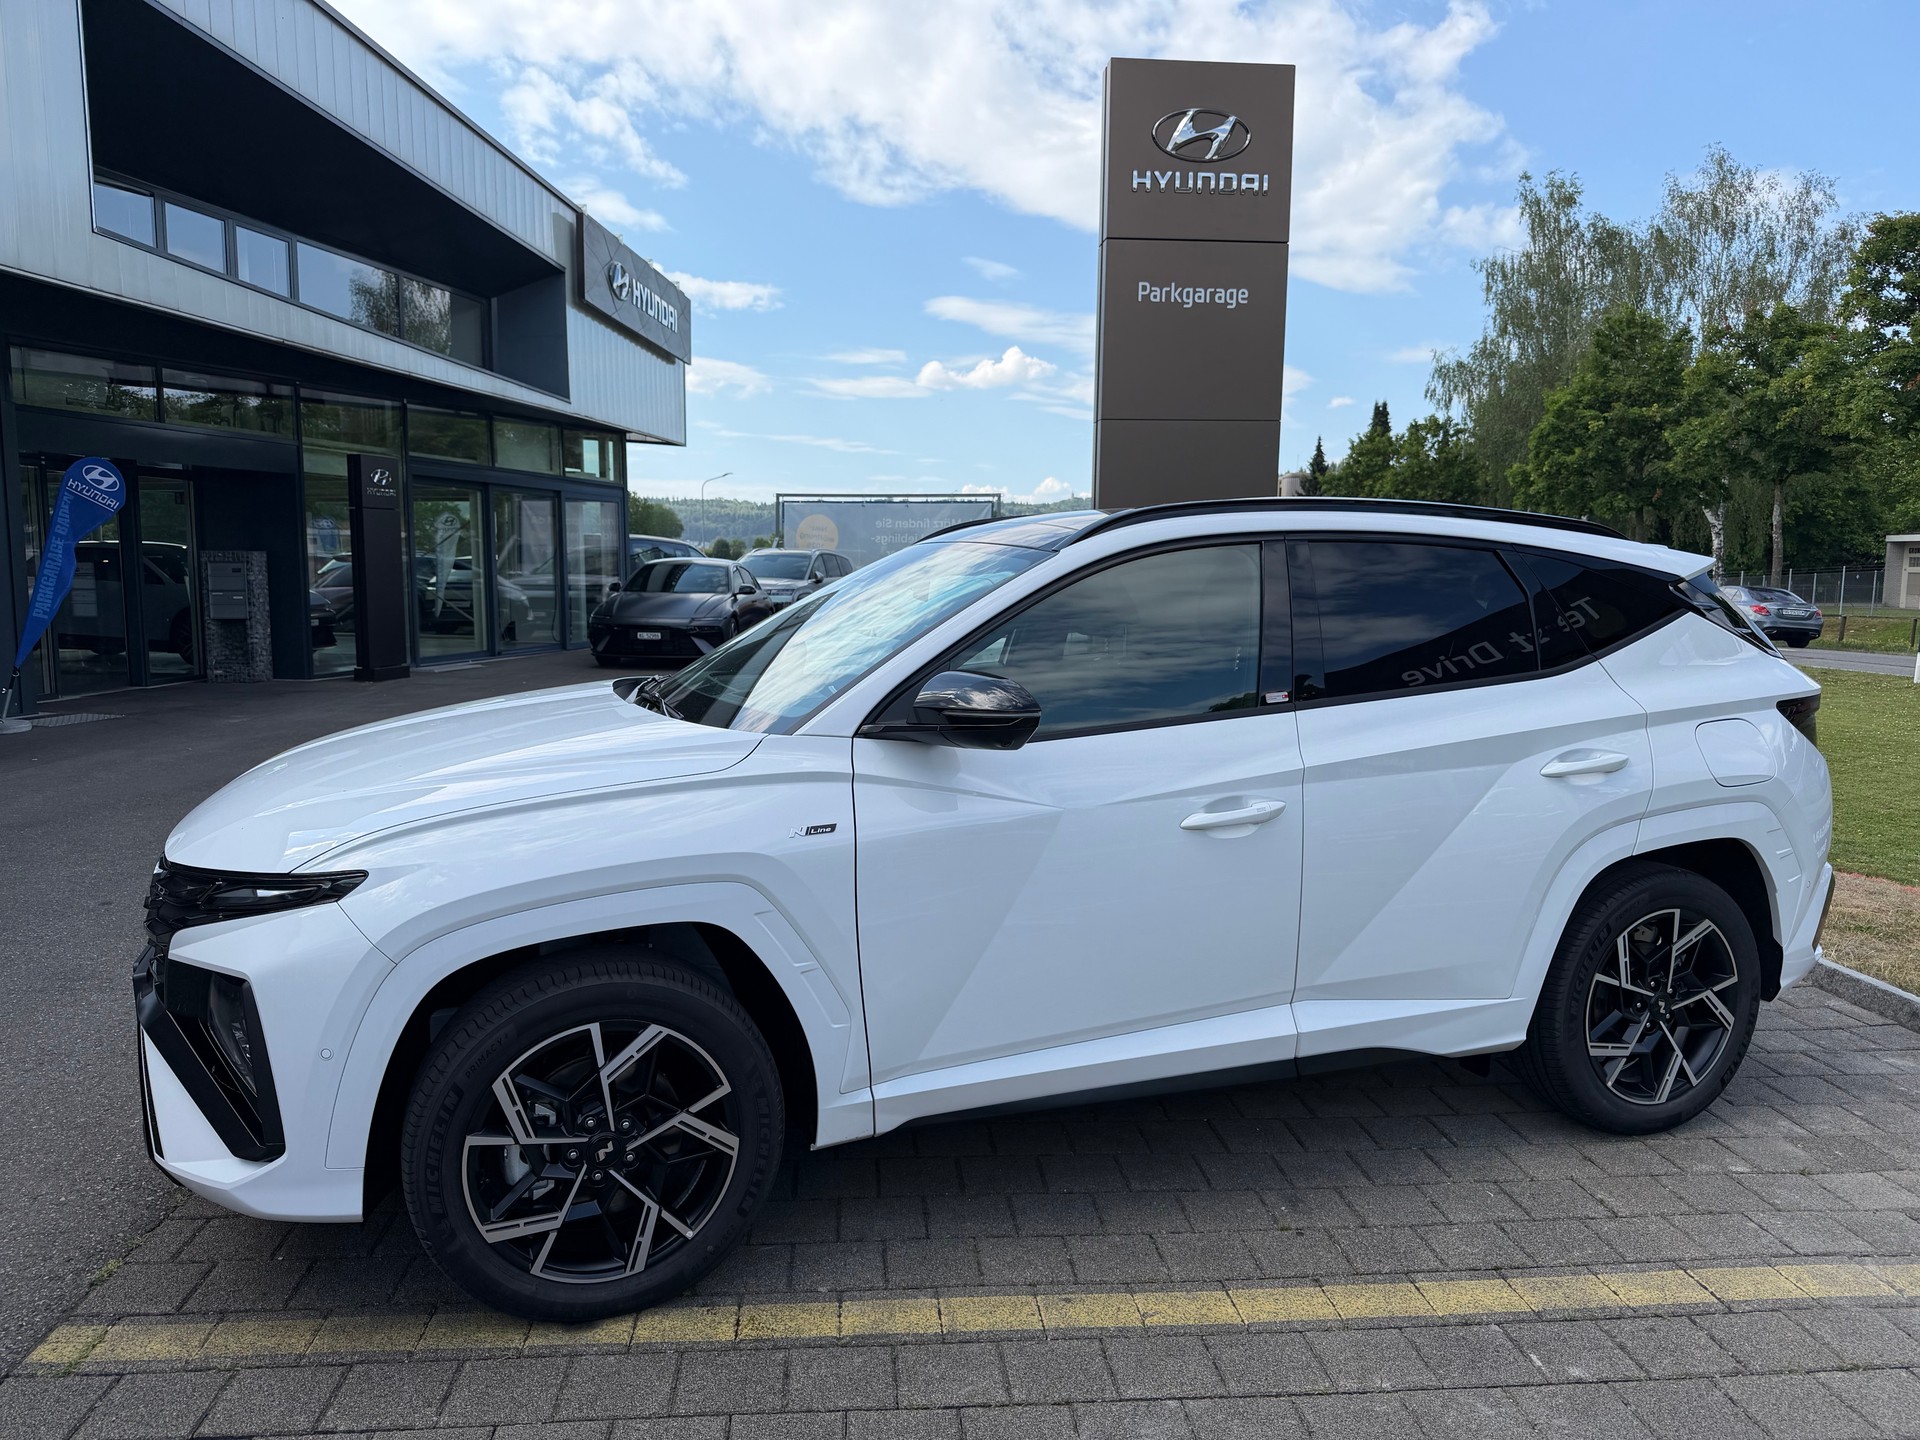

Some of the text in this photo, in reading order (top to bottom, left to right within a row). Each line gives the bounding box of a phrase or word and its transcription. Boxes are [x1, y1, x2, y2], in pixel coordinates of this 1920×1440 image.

[1131, 169, 1269, 196] HYUNDAI
[632, 278, 678, 333] HYUNDAI
[1137, 281, 1249, 308] Parkgarage
[67, 478, 120, 511] HYUNDAI
[33, 491, 75, 620] PARKGARAGE BADEN
[465, 1037, 503, 1079] PRIMACY
[425, 1092, 460, 1214] MICHELIN
